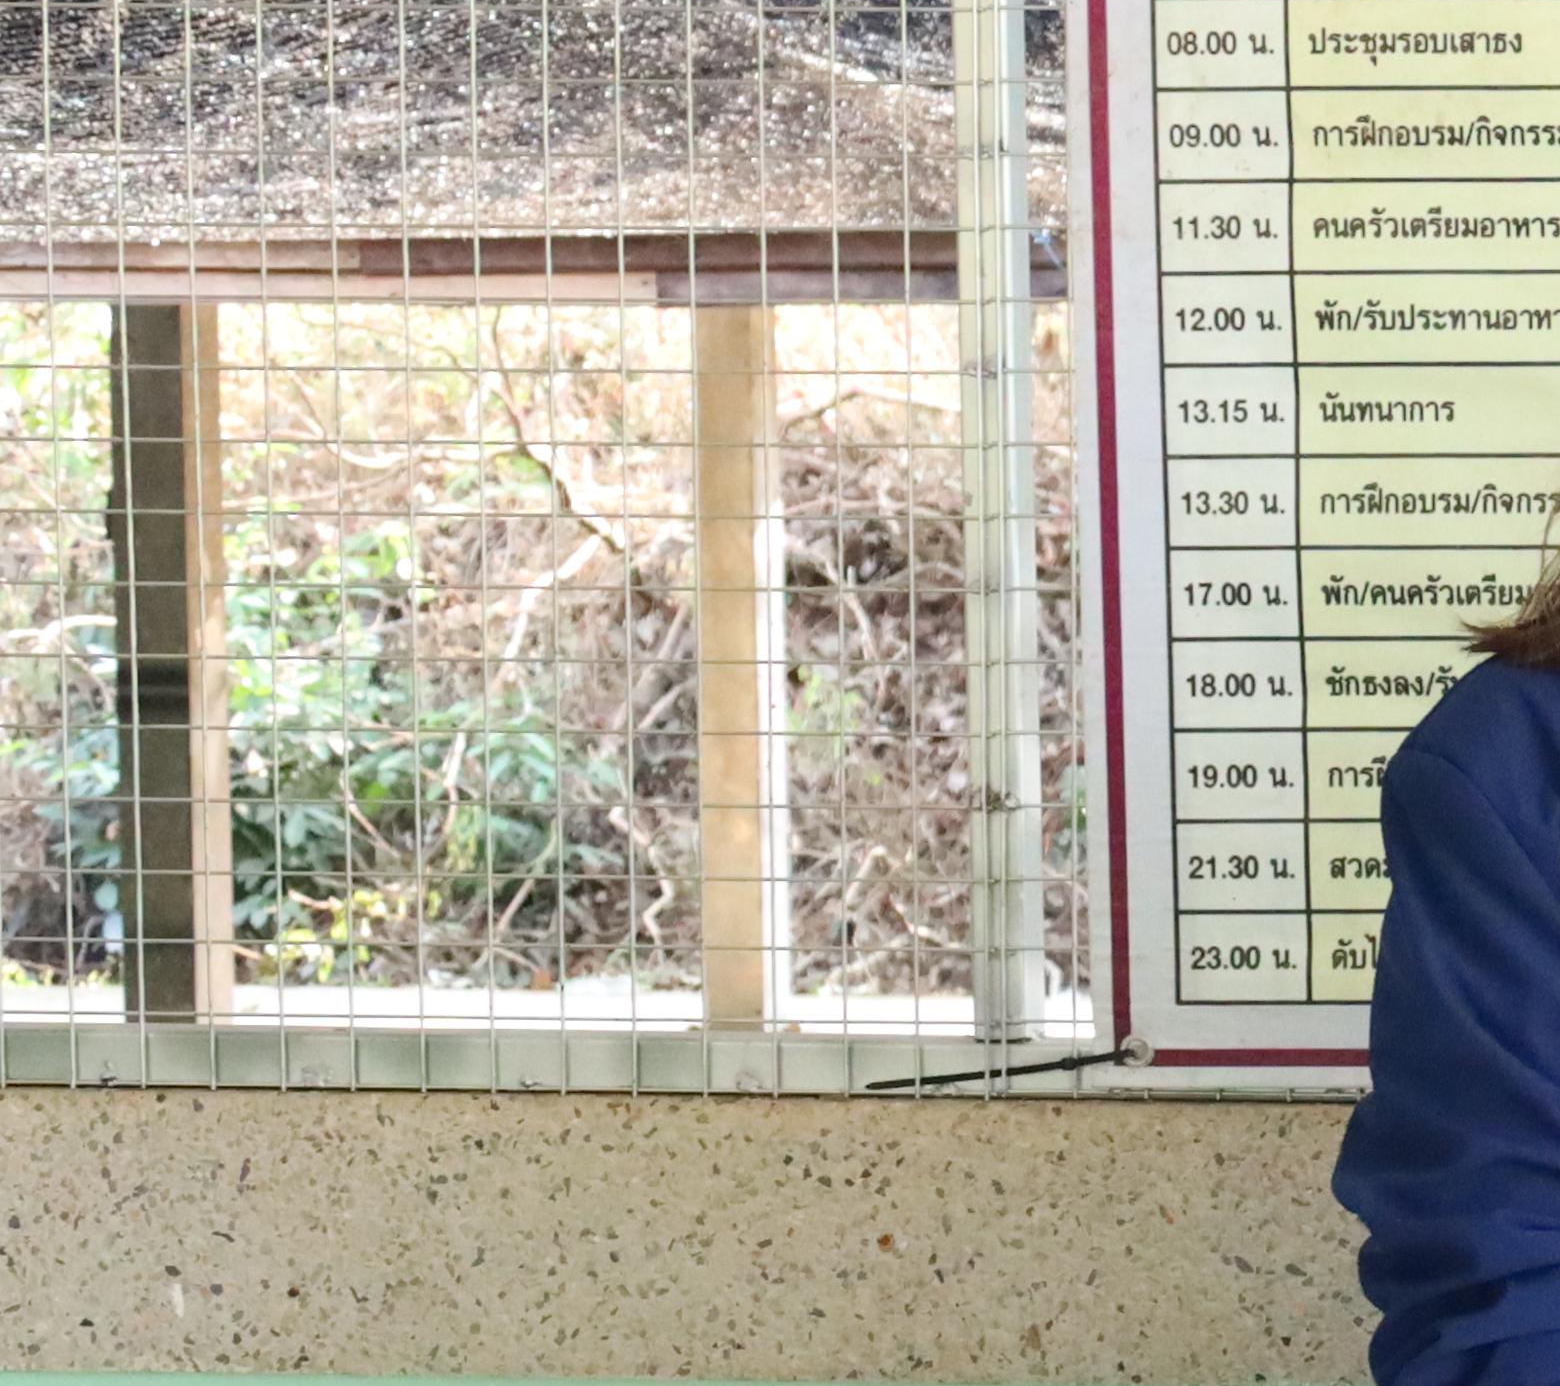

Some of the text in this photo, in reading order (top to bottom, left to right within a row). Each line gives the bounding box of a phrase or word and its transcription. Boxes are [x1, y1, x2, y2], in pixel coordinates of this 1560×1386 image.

[1166, 30, 1275, 56] 08.00 น.
[1307, 26, 1523, 67] ประชุมรอบเสาธง
[1169, 123, 1279, 149] 09.00 น.
[1172, 214, 1278, 240] 11.30 น.
[1312, 205, 1560, 239] คนครัวเตรียมอาหาร
[1175, 306, 1283, 332] 12.00 น.
[1178, 398, 1285, 424] 13.15 น.
[1318, 391, 1456, 423] นันทนาการ
[1181, 490, 1286, 516] 13.30 น.
[1183, 581, 1288, 607] 17.00 น.
[1186, 672, 1293, 698] 18.00 น.
[1187, 763, 1295, 789] 19.00 น.
[1188, 854, 1296, 880] 21.30 น.
[1190, 945, 1297, 971] 23.00 น.
